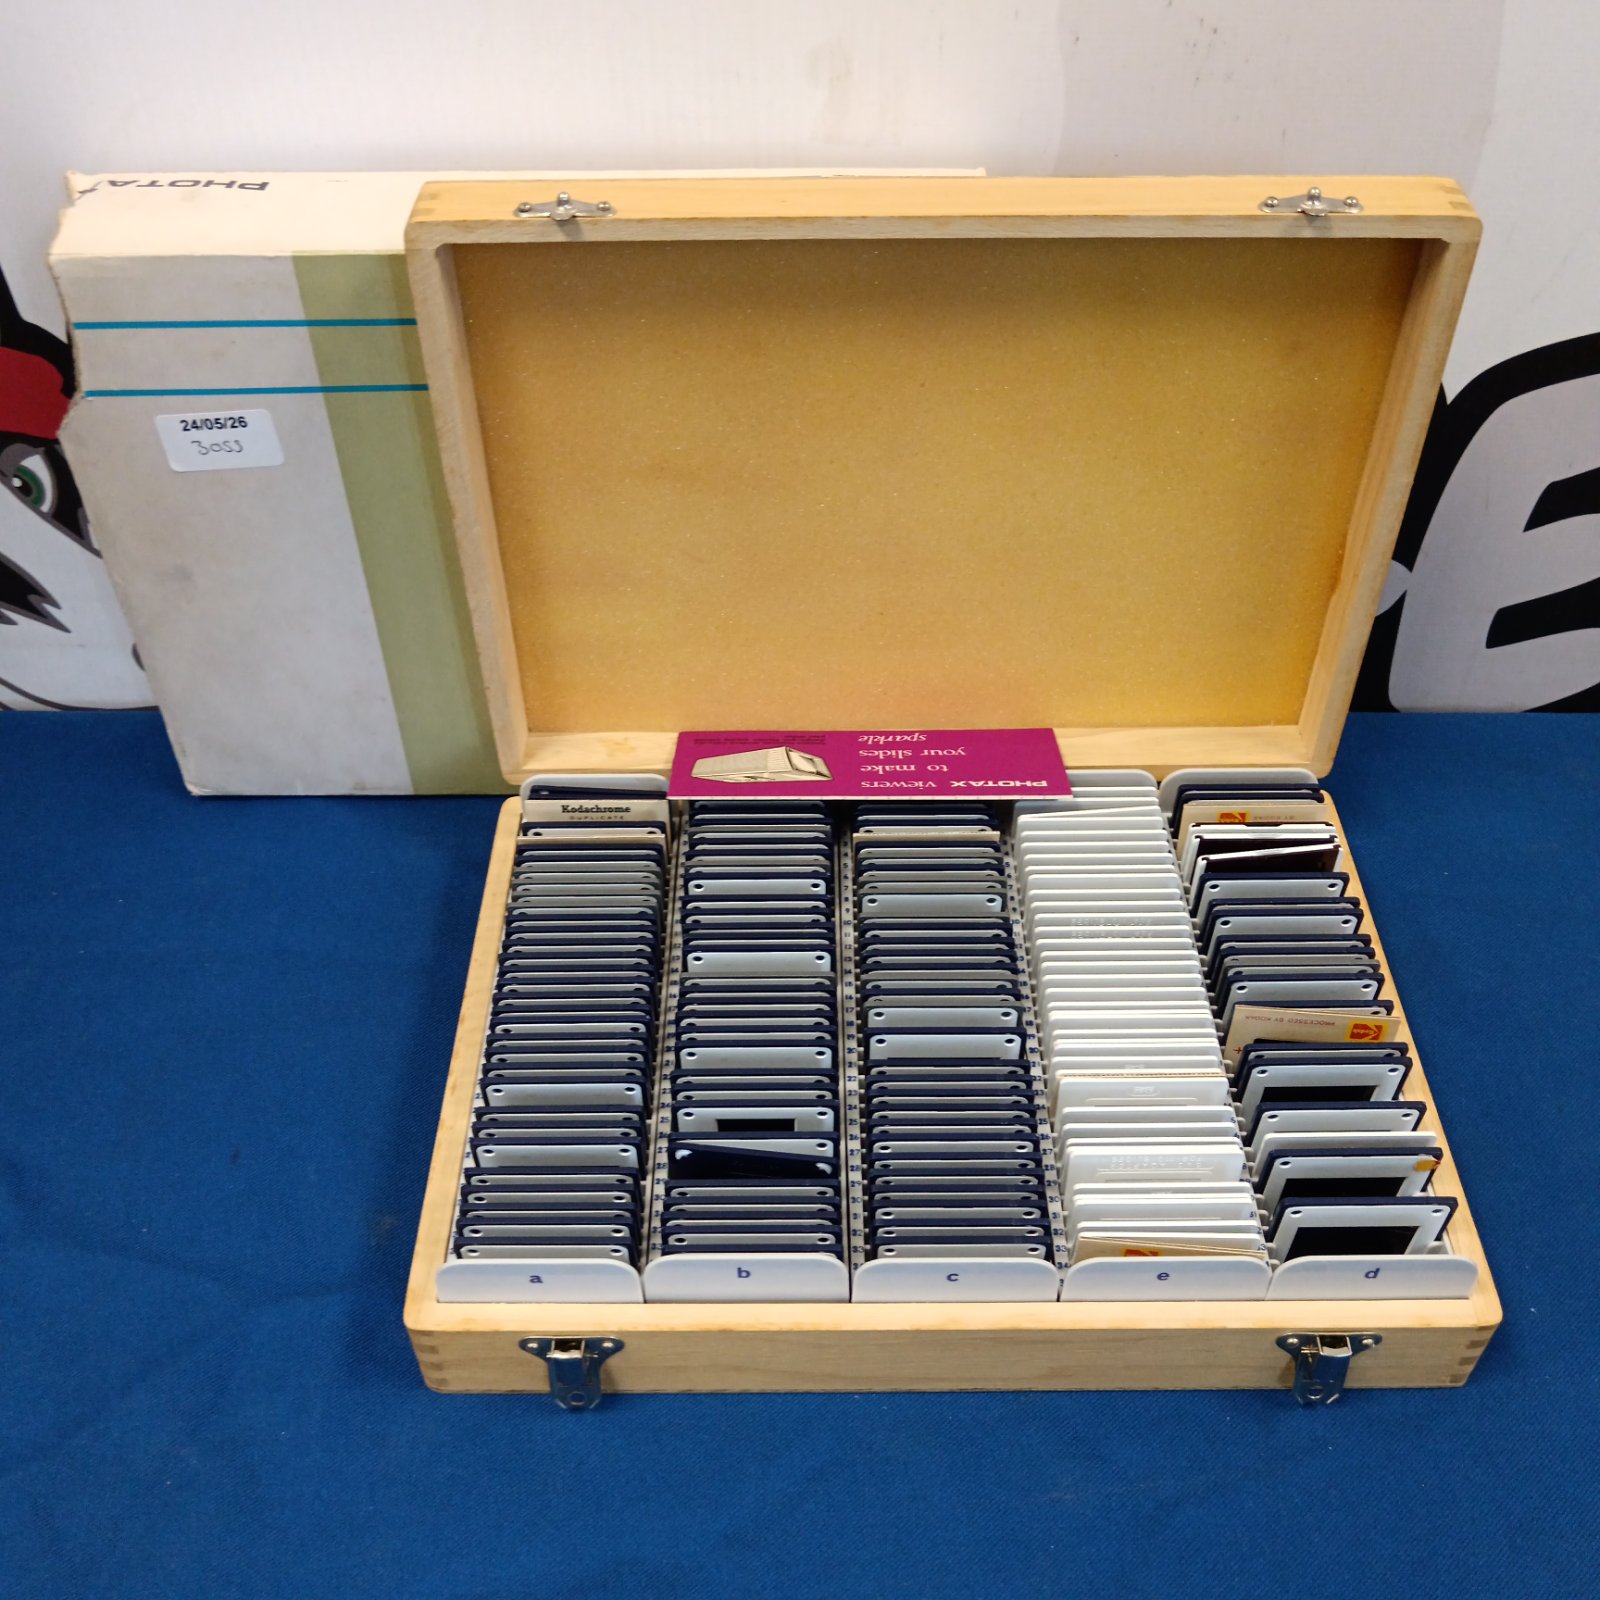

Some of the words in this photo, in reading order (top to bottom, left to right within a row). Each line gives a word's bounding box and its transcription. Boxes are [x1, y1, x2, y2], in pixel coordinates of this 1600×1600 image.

[180, 416, 248, 431] 24/05/26
[858, 732, 927, 744] sparkle
[859, 749, 912, 759] slides
[920, 747, 967, 756] your
[860, 765, 916, 775] make
[926, 765, 949, 773] to
[861, 780, 937, 790] viewers
[950, 779, 1049, 788] PHOTAX
[561, 804, 631, 813] Kodachrome
[737, 1266, 751, 1279] b
[946, 1272, 960, 1282] c
[1156, 1271, 1170, 1281] e
[1365, 1266, 1382, 1280] d
[529, 1274, 544, 1284] a
